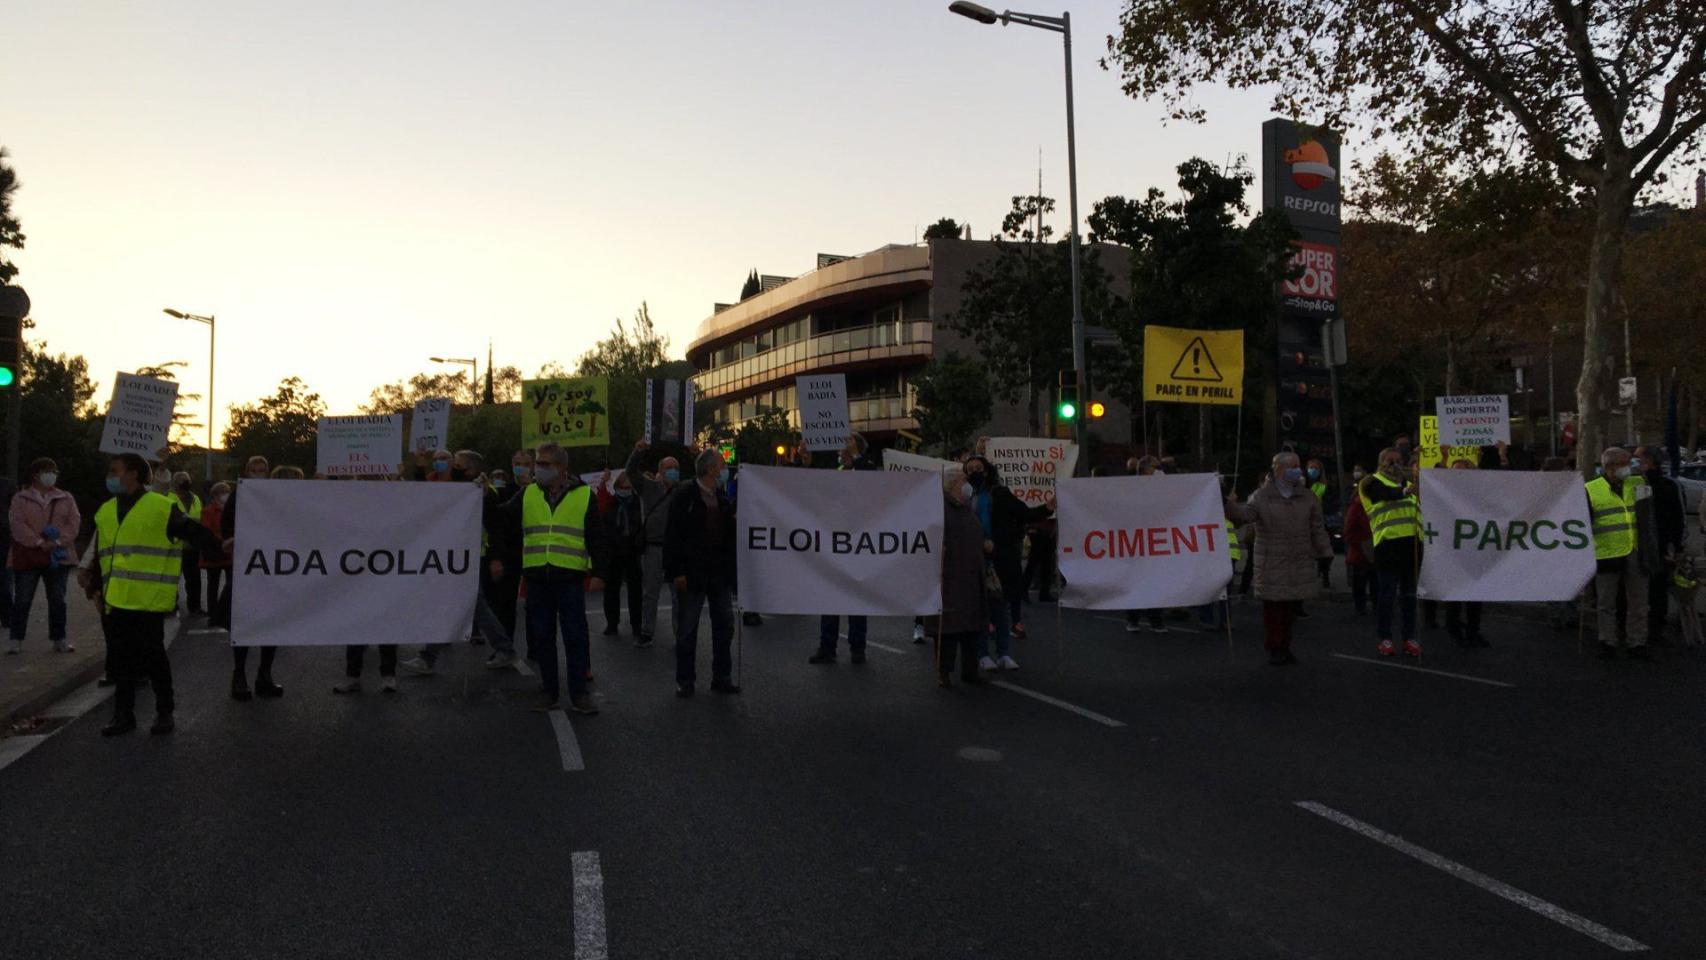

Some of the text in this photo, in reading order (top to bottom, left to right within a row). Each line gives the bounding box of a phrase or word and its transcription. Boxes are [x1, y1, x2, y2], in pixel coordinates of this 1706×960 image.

[1284, 195, 1336, 216] REPSOL
[1296, 297, 1335, 312] Stop&Go
[809, 381, 832, 390] ELOI
[1156, 383, 1234, 398] PARC EN PERILL
[534, 385, 592, 409] Yo soy
[808, 392, 837, 401] BADIA
[1443, 396, 1502, 405] BARCELONA
[556, 404, 575, 416] tu
[818, 411, 832, 419] NO
[1446, 406, 1499, 415] DESPIERTA!
[109, 415, 162, 432] DESTRUIN
[357, 415, 392, 425] BADIA
[805, 421, 845, 430] ESCOLTA
[1453, 417, 1500, 426] CEMENTO
[118, 428, 153, 441] ESPAIS
[1462, 427, 1494, 436] ZONAS
[113, 438, 147, 450] VERDS
[994, 449, 1045, 458] INSTITUT
[1422, 447, 1438, 458] ES
[1033, 461, 1055, 474] NO
[748, 527, 930, 554] ELOI BADIA
[1454, 519, 1589, 550] PARCS
[1084, 524, 1219, 559] CIMENT
[245, 549, 470, 575] ADA COLAU
